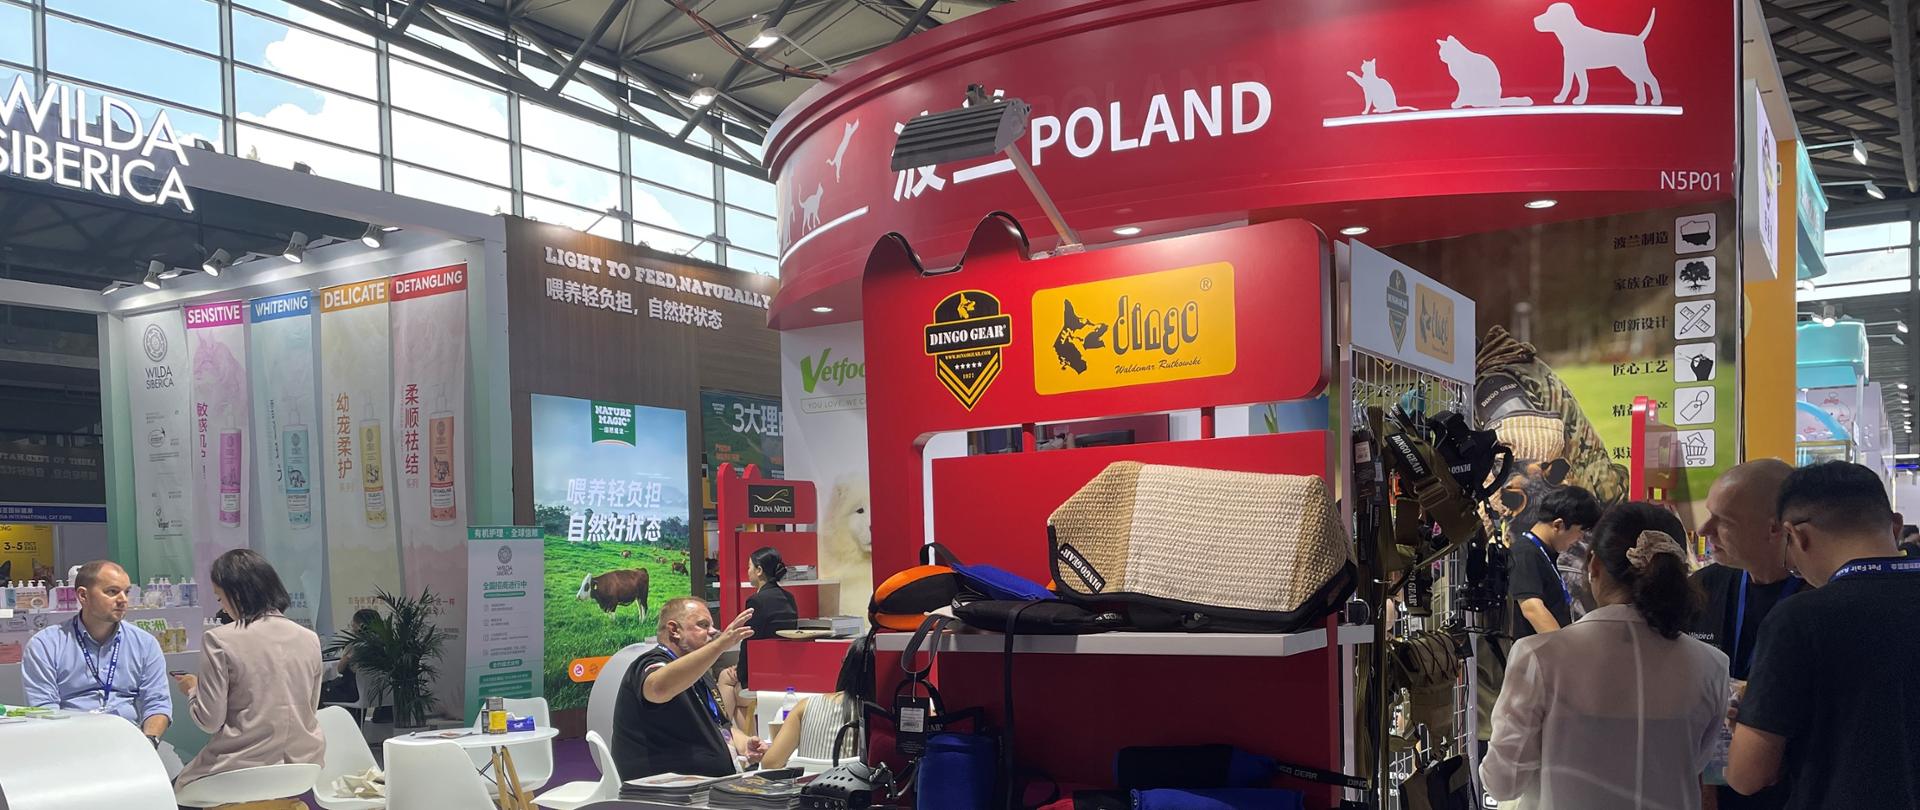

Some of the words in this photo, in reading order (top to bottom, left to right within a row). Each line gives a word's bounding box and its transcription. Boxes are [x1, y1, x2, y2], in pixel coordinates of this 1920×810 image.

[0, 73, 190, 166] WILDA
[1031, 80, 1272, 167] POLAND
[0, 129, 195, 212] SIBERICA
[1660, 170, 1721, 191] N5P01
[1613, 231, 1669, 250] 波兰制造
[544, 246, 602, 275] LIGHT
[607, 259, 632, 280] TO
[395, 270, 463, 294] DETANGLING
[1614, 274, 1669, 291] 家族企业
[324, 282, 385, 308] DELICATE
[187, 304, 241, 324] SENSITIVE
[254, 295, 308, 317] WHITENING
[1613, 316, 1669, 333] 创新设计
[929, 327, 967, 347] DINGO
[145, 365, 173, 379] WILDA
[1114, 364, 1155, 375] Waldemar
[1612, 359, 1668, 377] 匠心工艺
[146, 377, 174, 390] SIBERICA
[1480, 390, 1500, 408] DINGO
[594, 405, 631, 418] NATURE
[336, 392, 352, 479] 幼宠柔护
[405, 383, 419, 475] 柔顺祛结
[566, 478, 662, 508] 喂养轻负担
[4, 542, 23, 551] 3-5
[1079, 566, 1102, 592] DINGO
